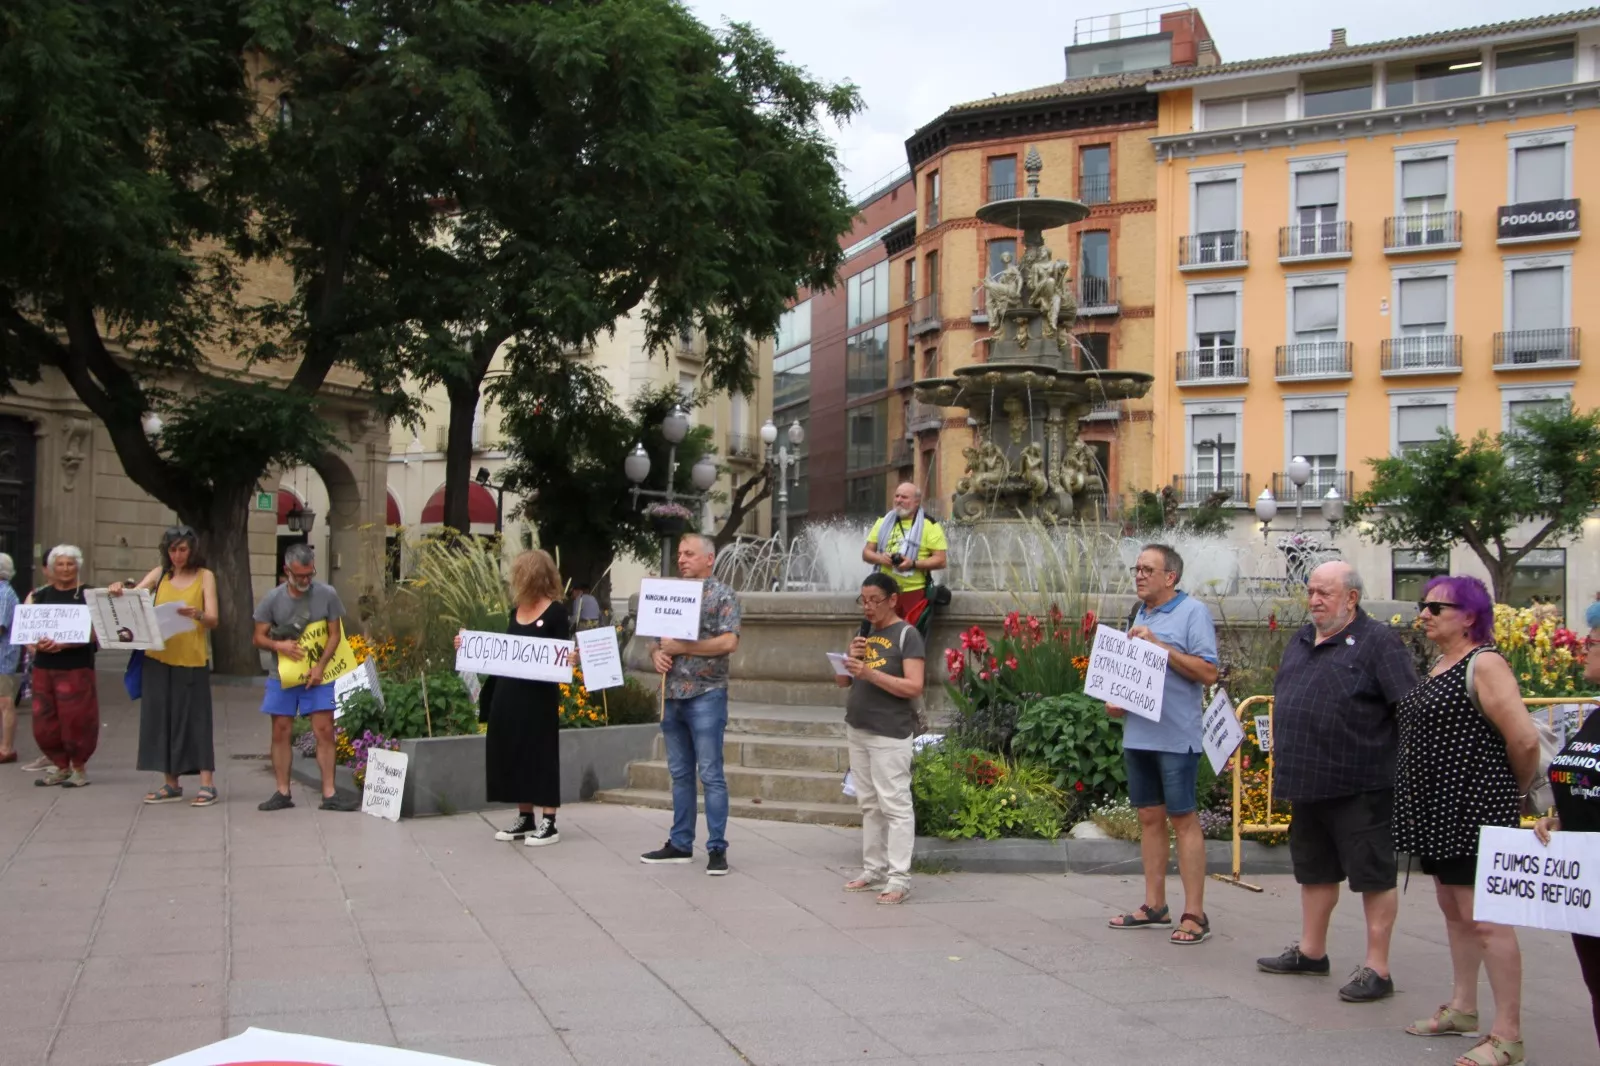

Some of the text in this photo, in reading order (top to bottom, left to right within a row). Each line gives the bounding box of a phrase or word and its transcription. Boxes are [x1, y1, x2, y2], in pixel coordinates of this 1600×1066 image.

[1500, 209, 1576, 226] PODÓLOGO
[645, 594, 668, 602] NINGUNA
[460, 635, 508, 661] ACOGIDA
[512, 639, 549, 665] DIGNA
[1098, 634, 1167, 674] DERECHO DEL MENOR
[1093, 654, 1152, 690] EXTRANJERO A
[1089, 675, 1155, 712] SER ESCUCHADO
[1493, 851, 1580, 881] FUIMOS EXILIO
[1486, 875, 1592, 909] SEAMOS REFUGIO
